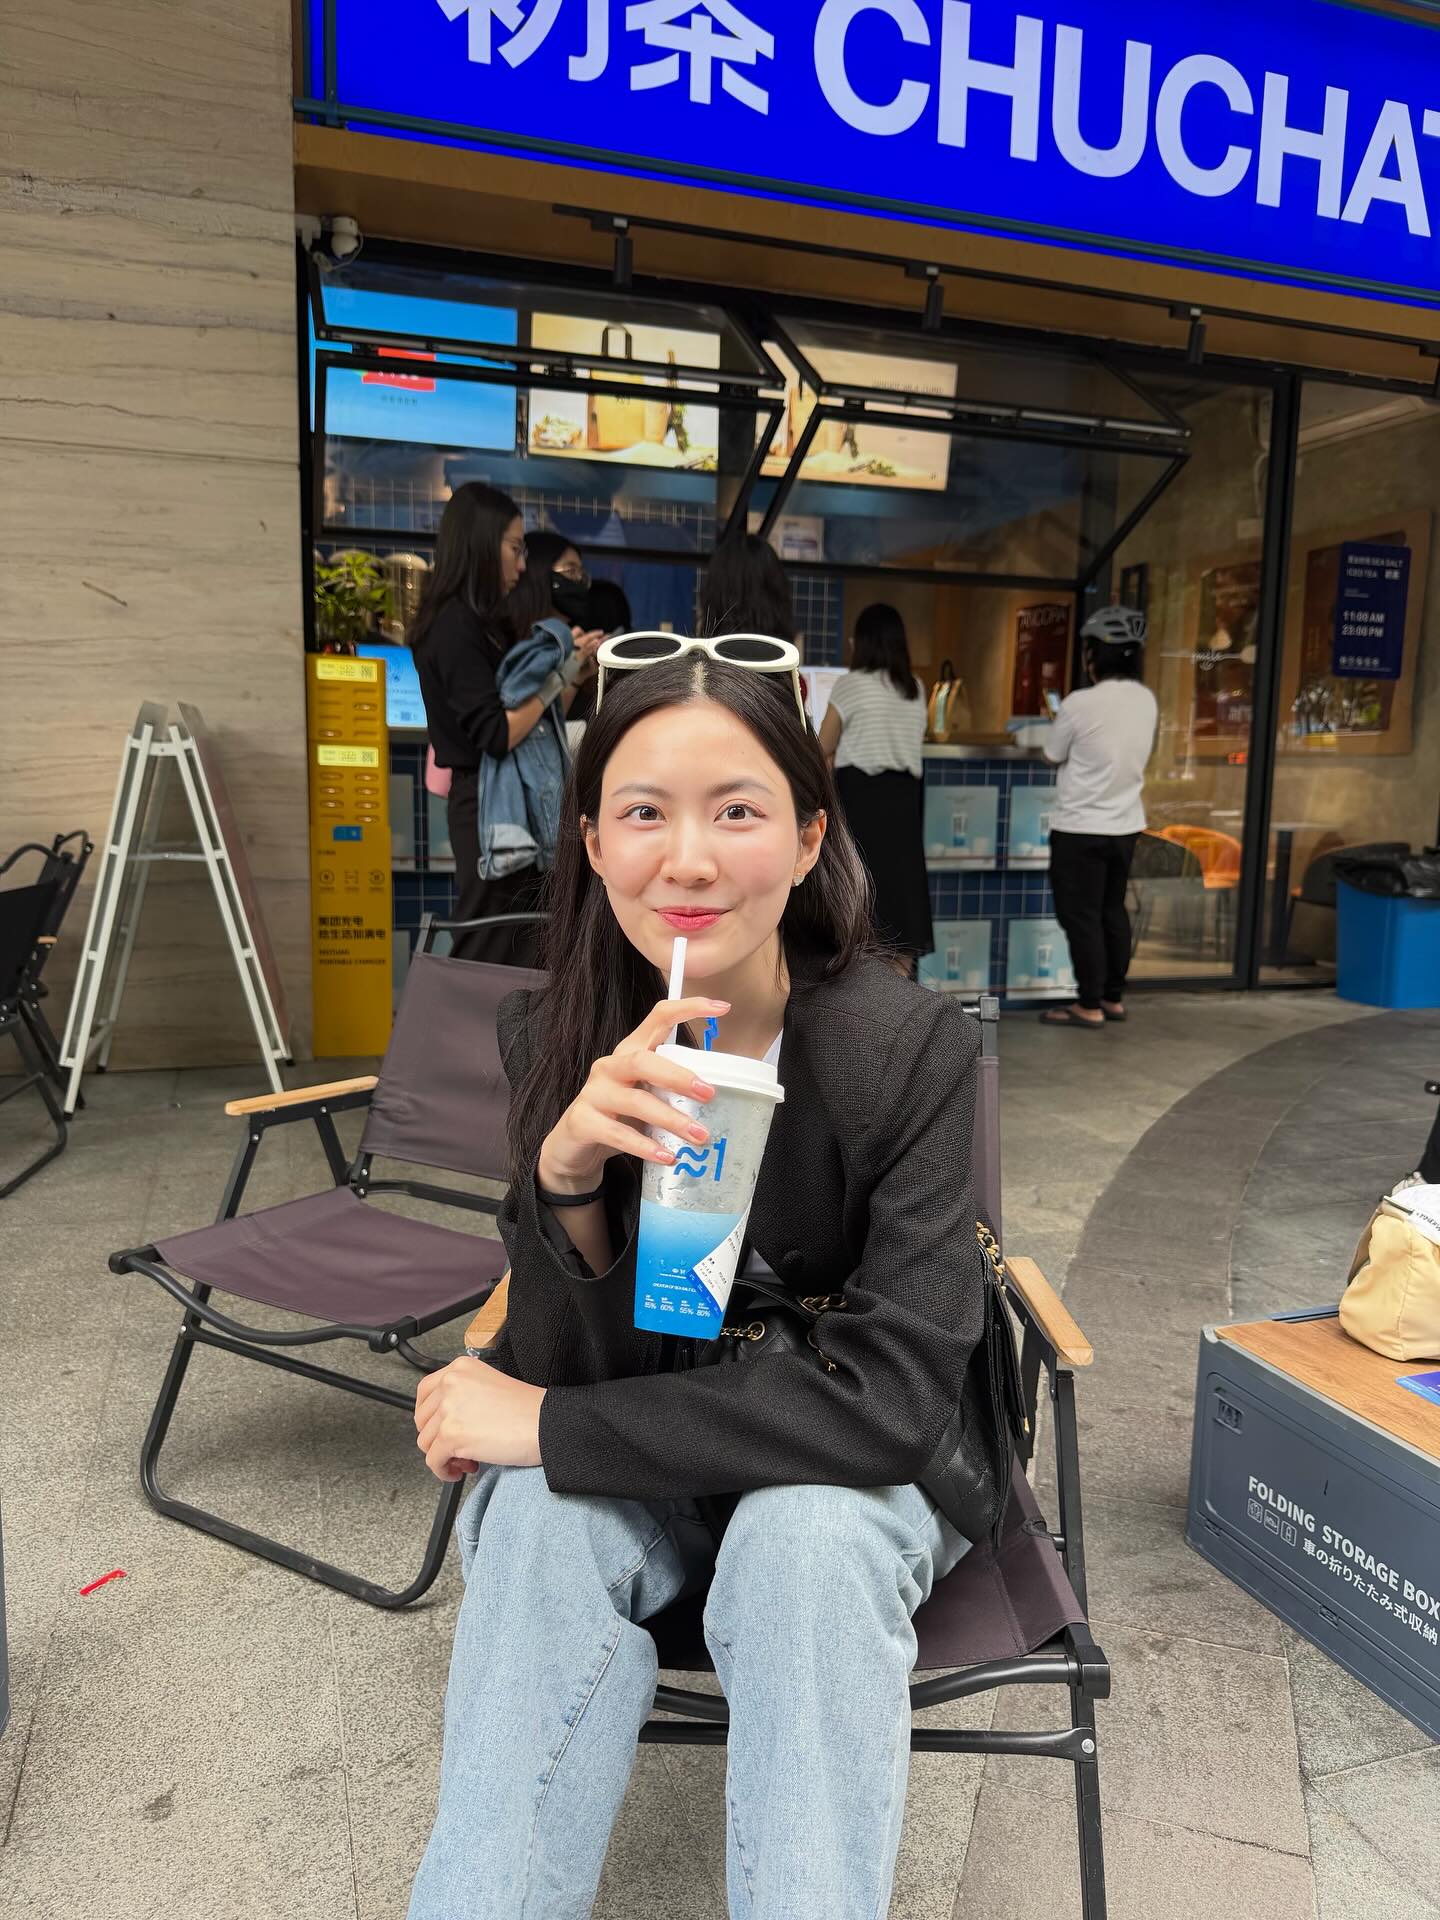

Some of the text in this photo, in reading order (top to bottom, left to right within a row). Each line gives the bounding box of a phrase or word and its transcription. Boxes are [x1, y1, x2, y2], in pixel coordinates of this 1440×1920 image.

[814, 0, 1440, 238] CHUCHA
[1343, 611, 1385, 624] 11:00 AM
[1368, 625, 1384, 637] PM
[1248, 1475, 1440, 1621] FOLDING STORAGE BOX
[1302, 1537, 1439, 1647] 車の折りたたみ式収納
